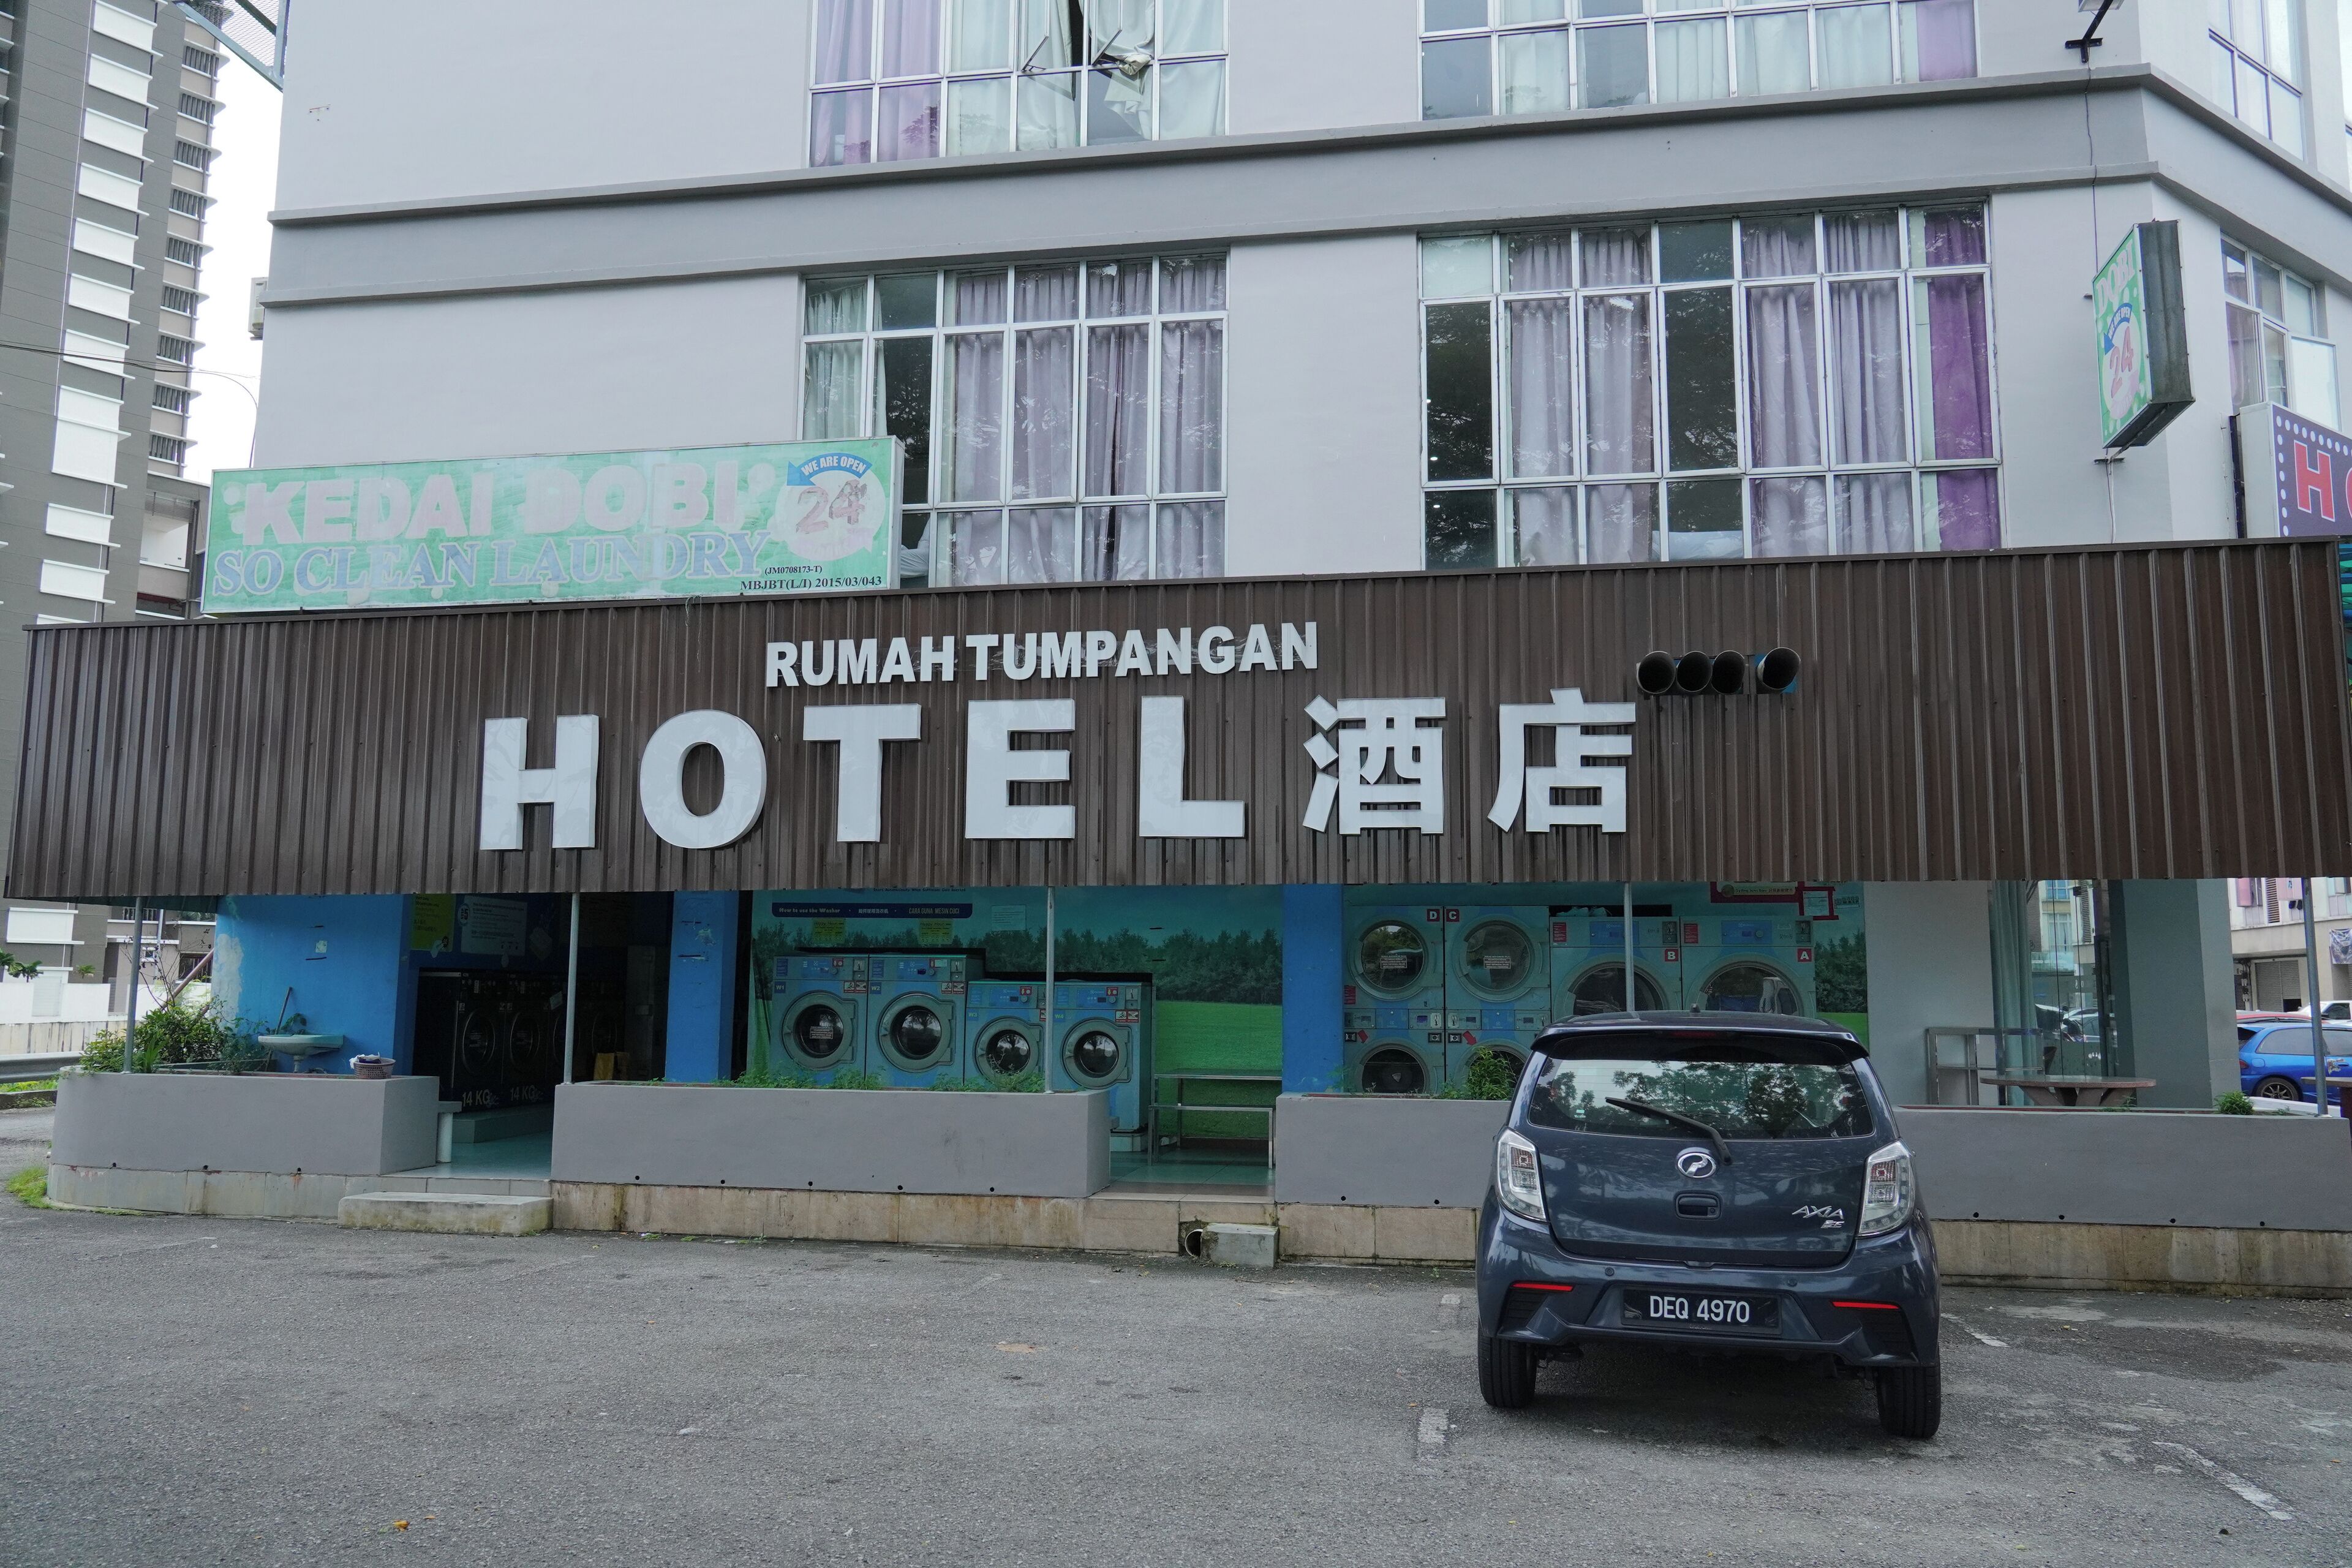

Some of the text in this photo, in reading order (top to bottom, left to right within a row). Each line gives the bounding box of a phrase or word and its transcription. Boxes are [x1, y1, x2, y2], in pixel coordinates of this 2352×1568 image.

[2096, 241, 2136, 318] DOBI
[2110, 326, 2134, 398] 24
[801, 455, 867, 476] WE ARE OPEN
[2294, 439, 2352, 522] H
[243, 461, 738, 545] KEDAI DOBI
[796, 478, 867, 534] 24
[213, 530, 771, 597] SO CLEAN LAUNDRY
[741, 576, 882, 591] MBJBT(L/I) 2015/03/043
[764, 565, 823, 575] (JM0708173-T)
[766, 621, 1318, 687] RUMAH TUMPANGAN
[480, 695, 1246, 851] HOTEL
[1302, 687, 1636, 834] 酒店
[462, 1091, 473, 1107] 14
[1792, 1205, 1844, 1219] AXIA
[1649, 1295, 1750, 1323] DEQ 4970
